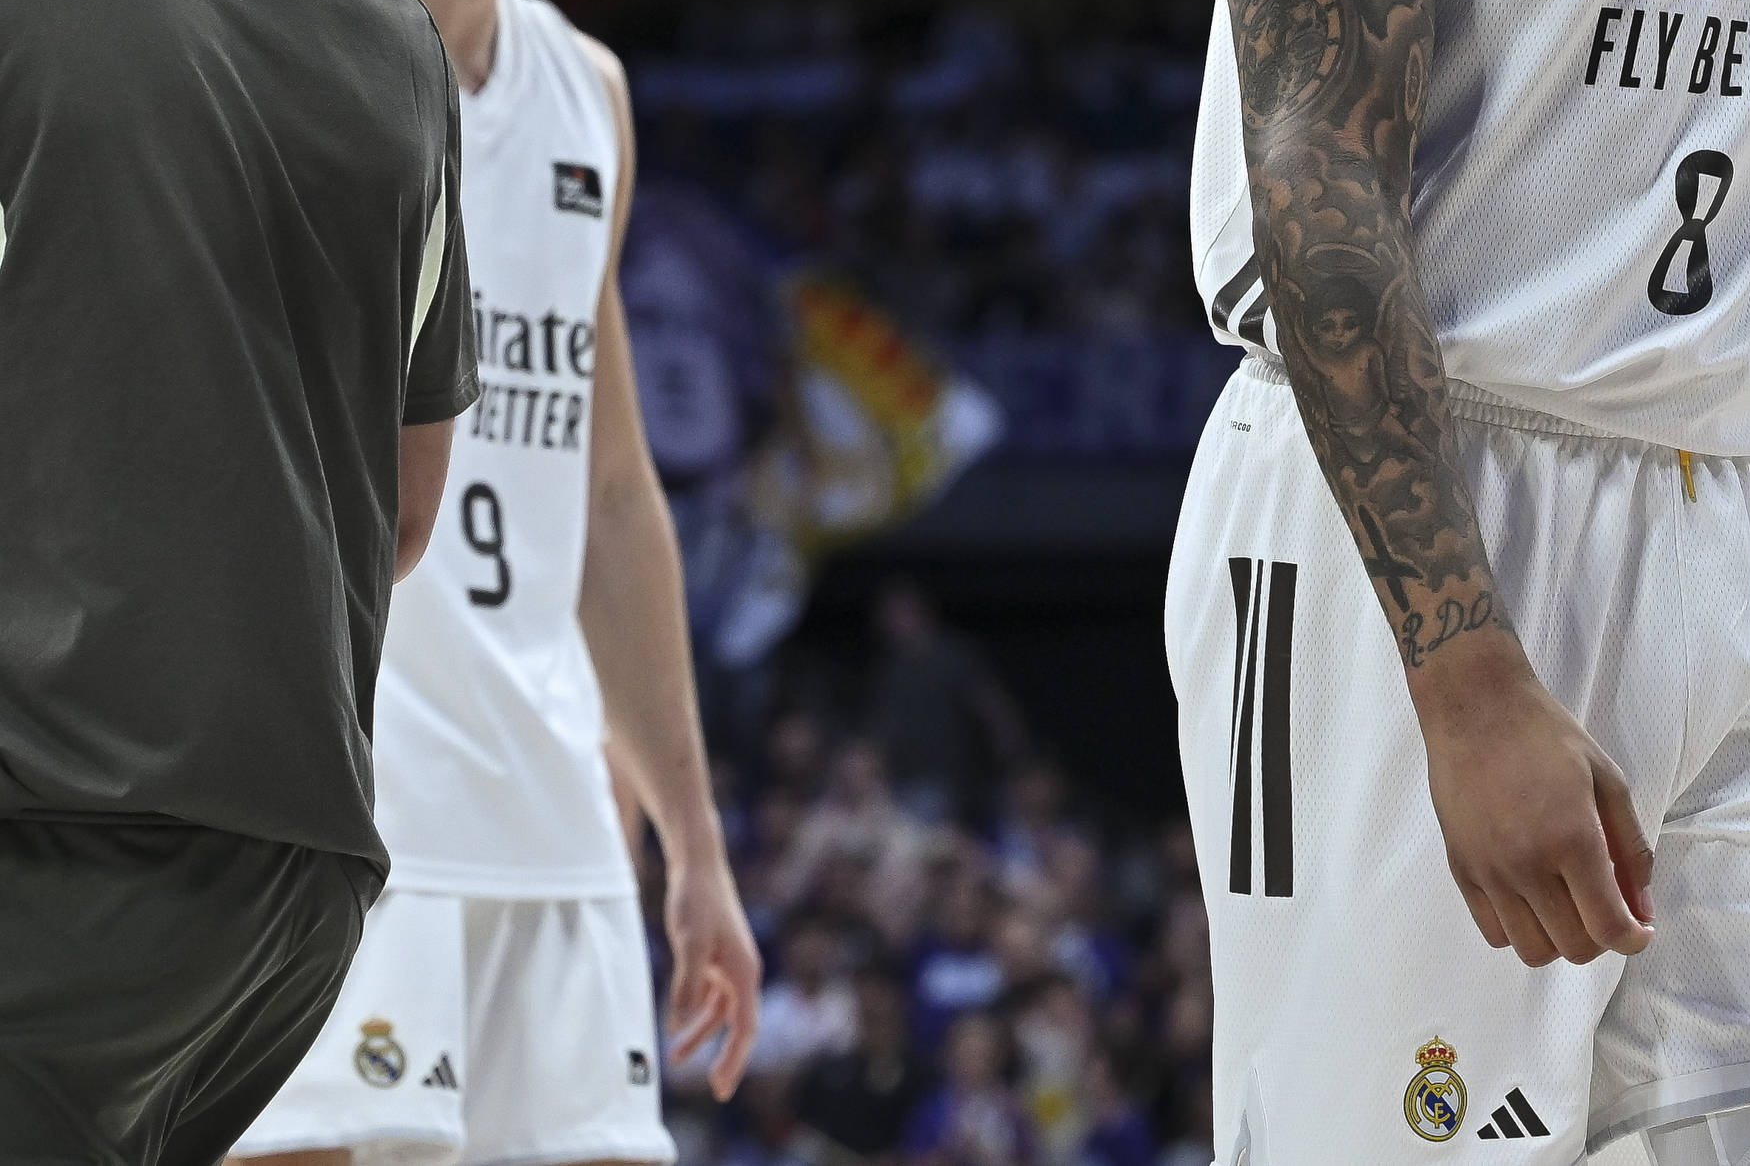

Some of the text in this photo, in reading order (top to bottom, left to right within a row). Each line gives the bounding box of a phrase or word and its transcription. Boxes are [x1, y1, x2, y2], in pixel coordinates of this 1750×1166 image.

[1584, 7, 1684, 91] FLY
[1647, 149, 1735, 316] 8
[473, 290, 596, 378] irate
[460, 481, 511, 608] 9
